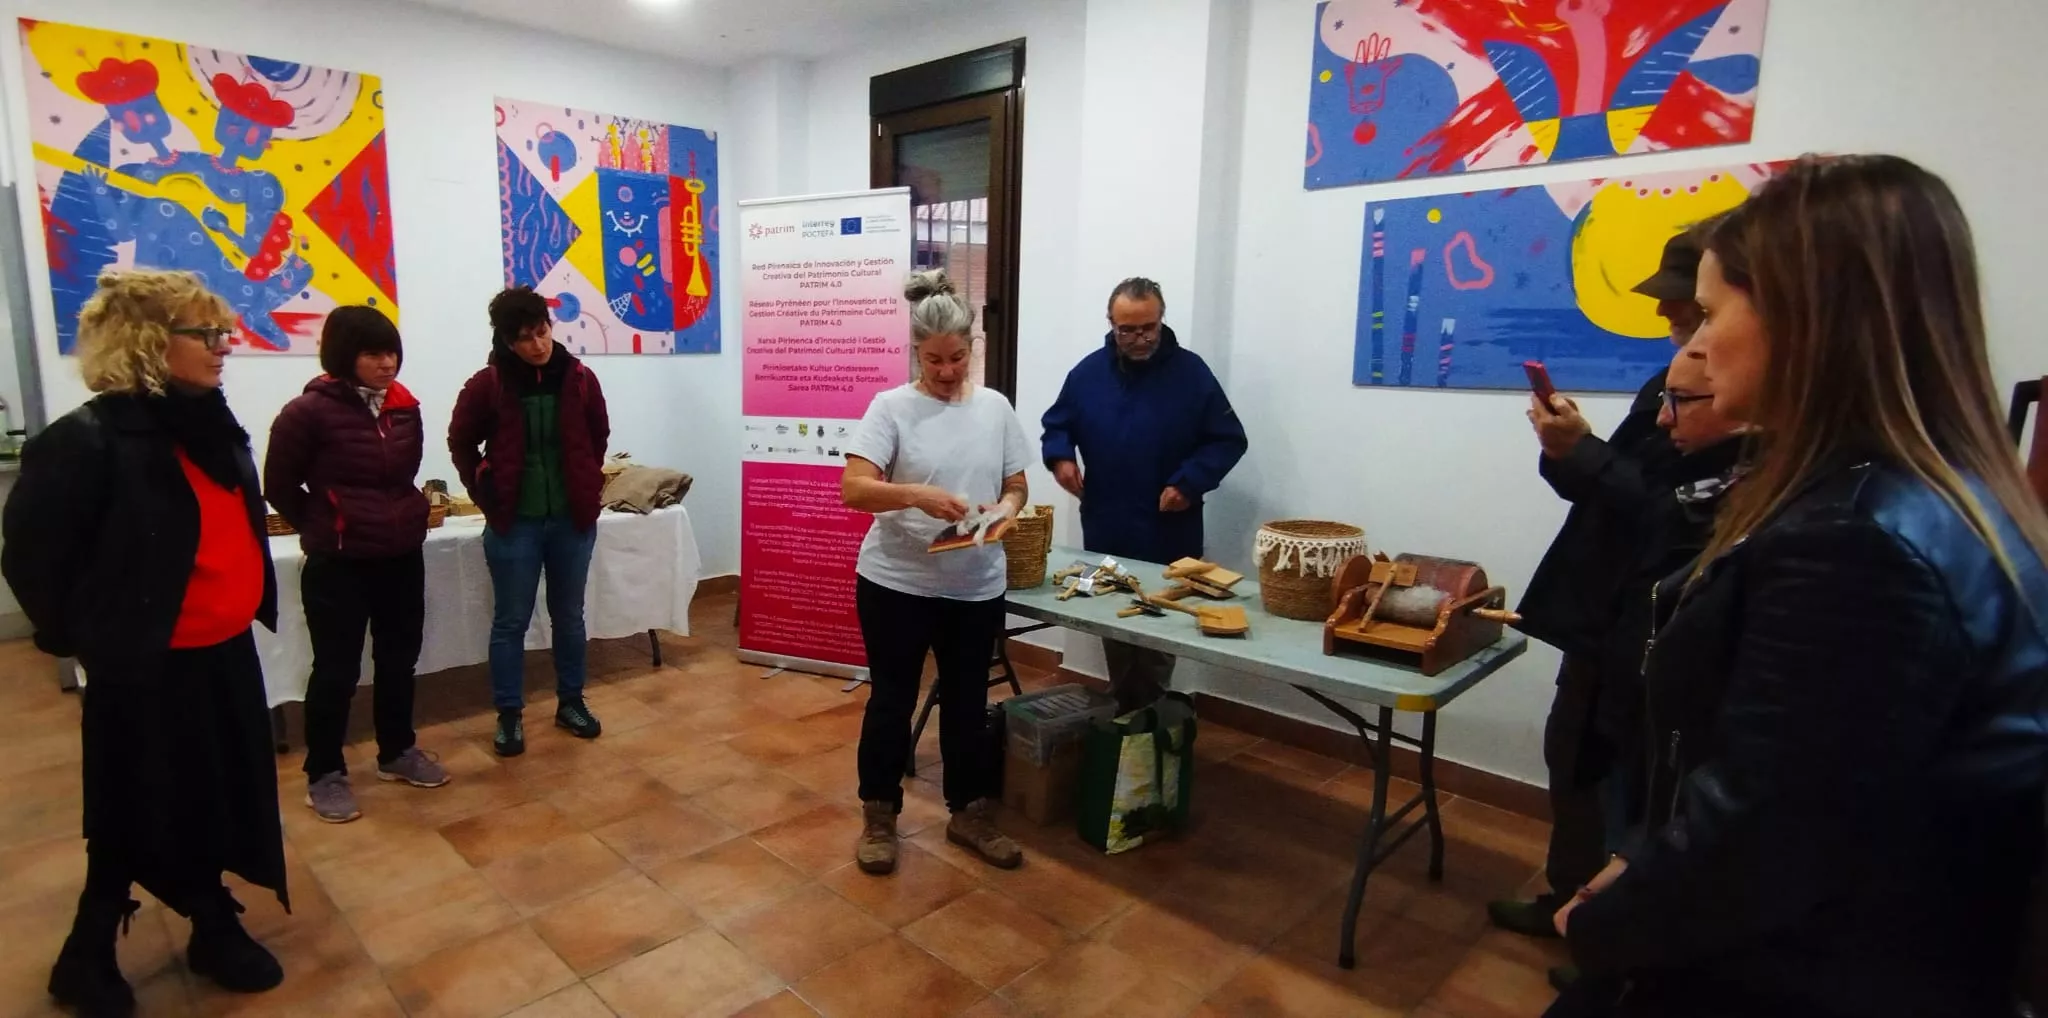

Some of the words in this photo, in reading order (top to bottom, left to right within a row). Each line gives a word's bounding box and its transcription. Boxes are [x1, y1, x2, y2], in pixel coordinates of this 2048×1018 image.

[765, 224, 796, 238] patrim
[802, 230, 835, 238] POCTEFA
[752, 262, 766, 270] Red
[803, 261, 813, 269] de
[814, 260, 856, 268] Innovación
[857, 260, 862, 270] y
[864, 258, 894, 266] Gestión
[763, 272, 792, 280] Creativa
[794, 271, 806, 280] del
[808, 270, 849, 278] Patrimonio
[850, 268, 882, 278] Cultural
[830, 280, 842, 288] 4.0
[890, 297, 897, 305] la
[810, 308, 820, 317] du
[821, 308, 863, 317] Patrimoine
[778, 336, 813, 344] Pirinenca
